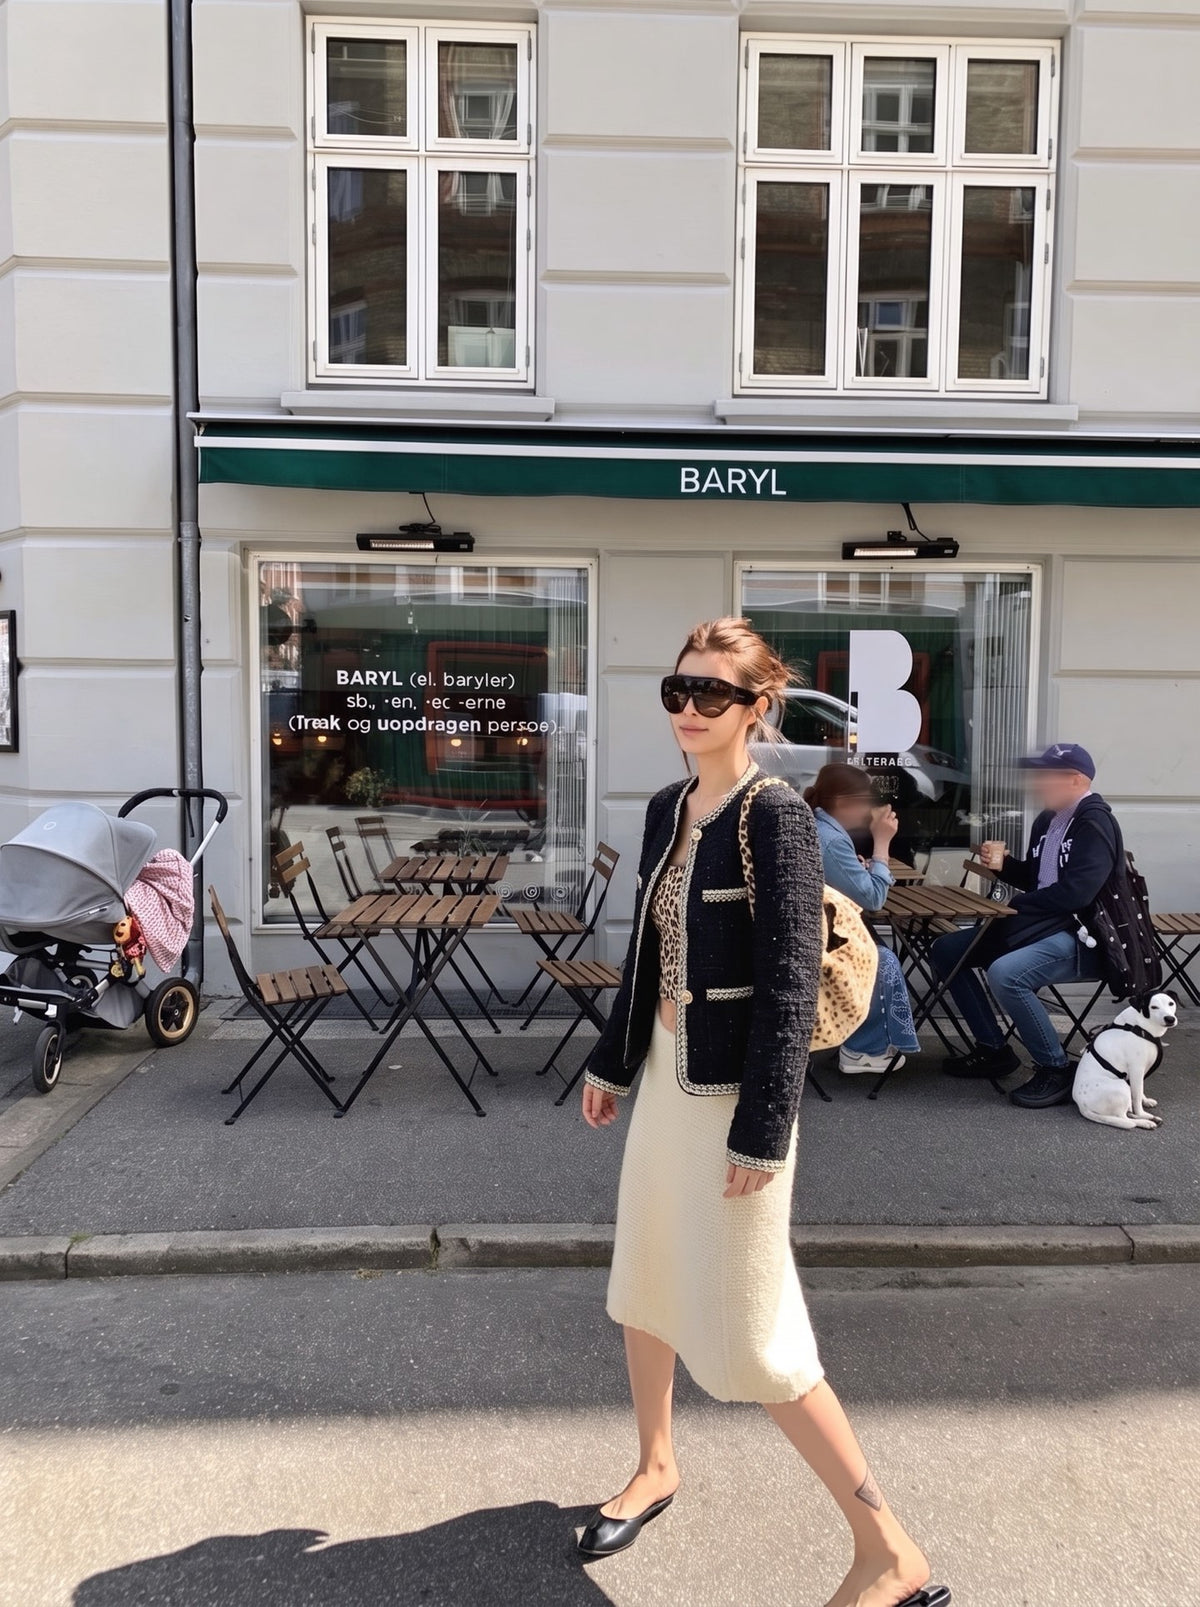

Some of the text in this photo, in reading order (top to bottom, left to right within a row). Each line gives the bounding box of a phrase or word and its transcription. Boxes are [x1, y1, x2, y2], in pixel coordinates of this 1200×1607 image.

[680, 467, 787, 496] BARYL
[336, 669, 515, 690] BARYL (el. baryler)
[347, 718, 371, 733] og
[377, 716, 481, 735] uopdragen
